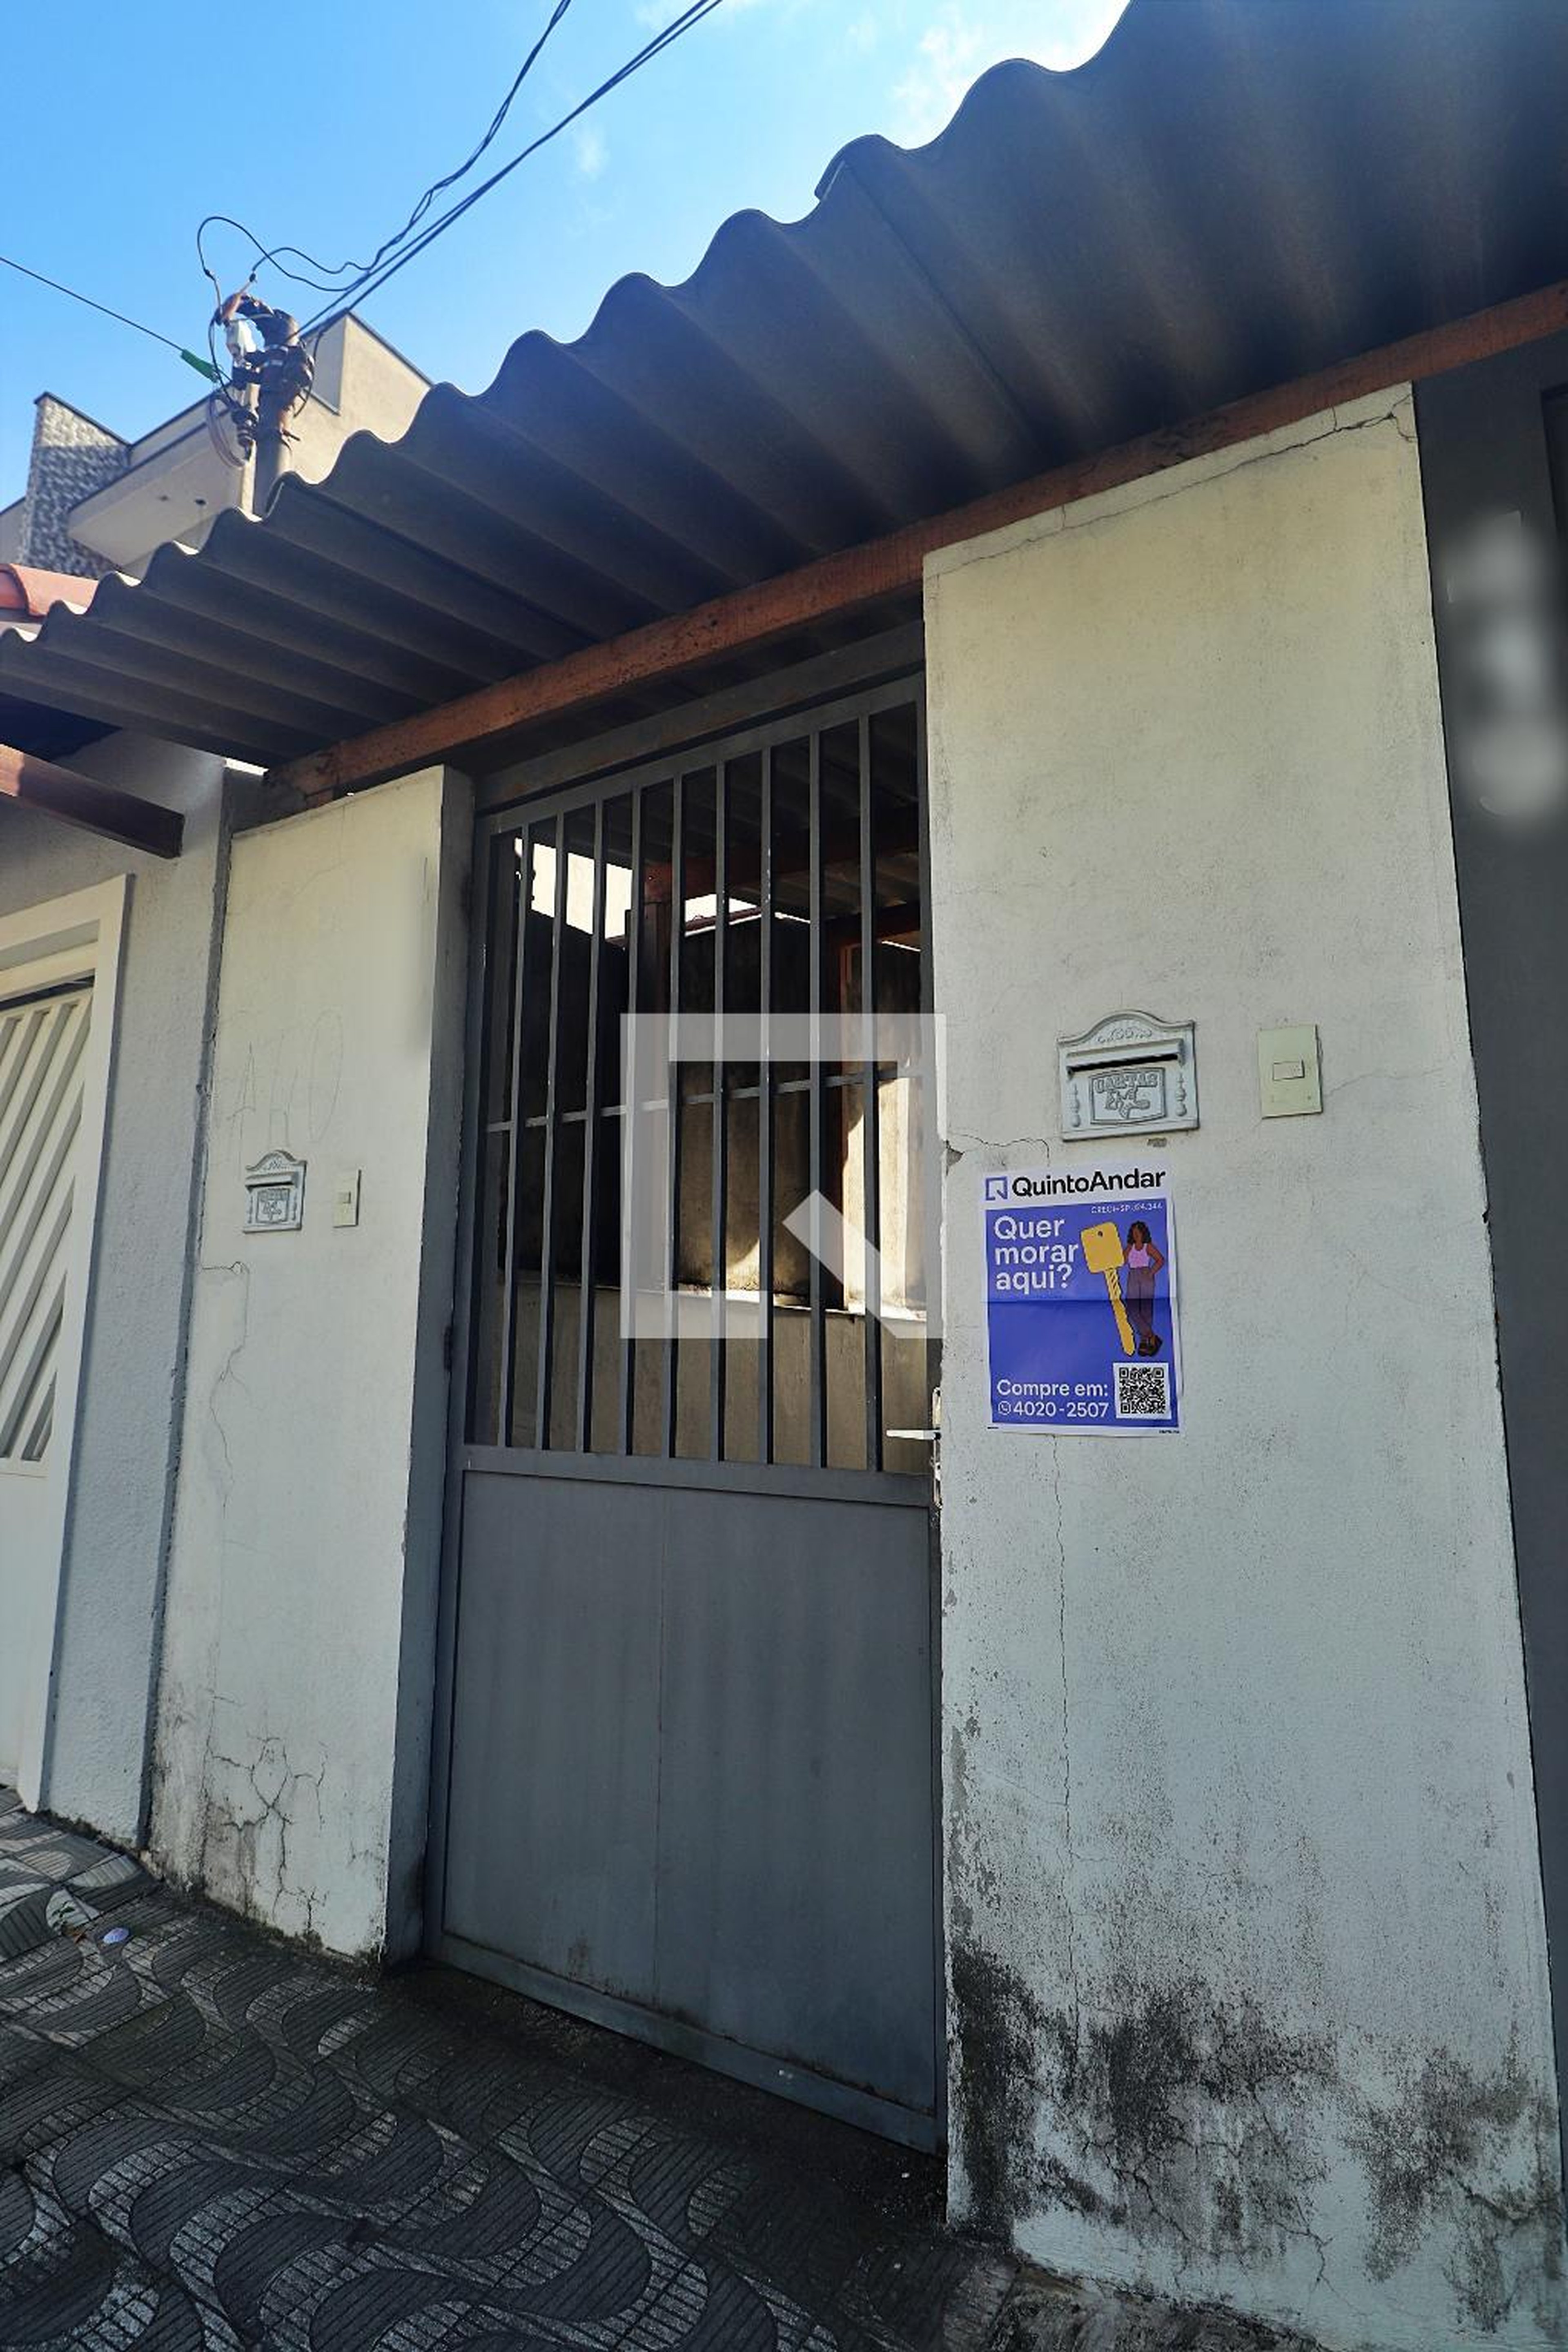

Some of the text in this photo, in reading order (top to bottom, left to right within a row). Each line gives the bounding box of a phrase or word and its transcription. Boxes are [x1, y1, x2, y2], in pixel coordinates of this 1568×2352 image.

[1011, 1168, 1166, 1197] QuintoAndar
[994, 1215, 1065, 1241] Quer
[995, 1243, 1079, 1265] morar
[996, 1263, 1073, 1295] aqui?
[997, 1379, 1108, 1400] Compre em:
